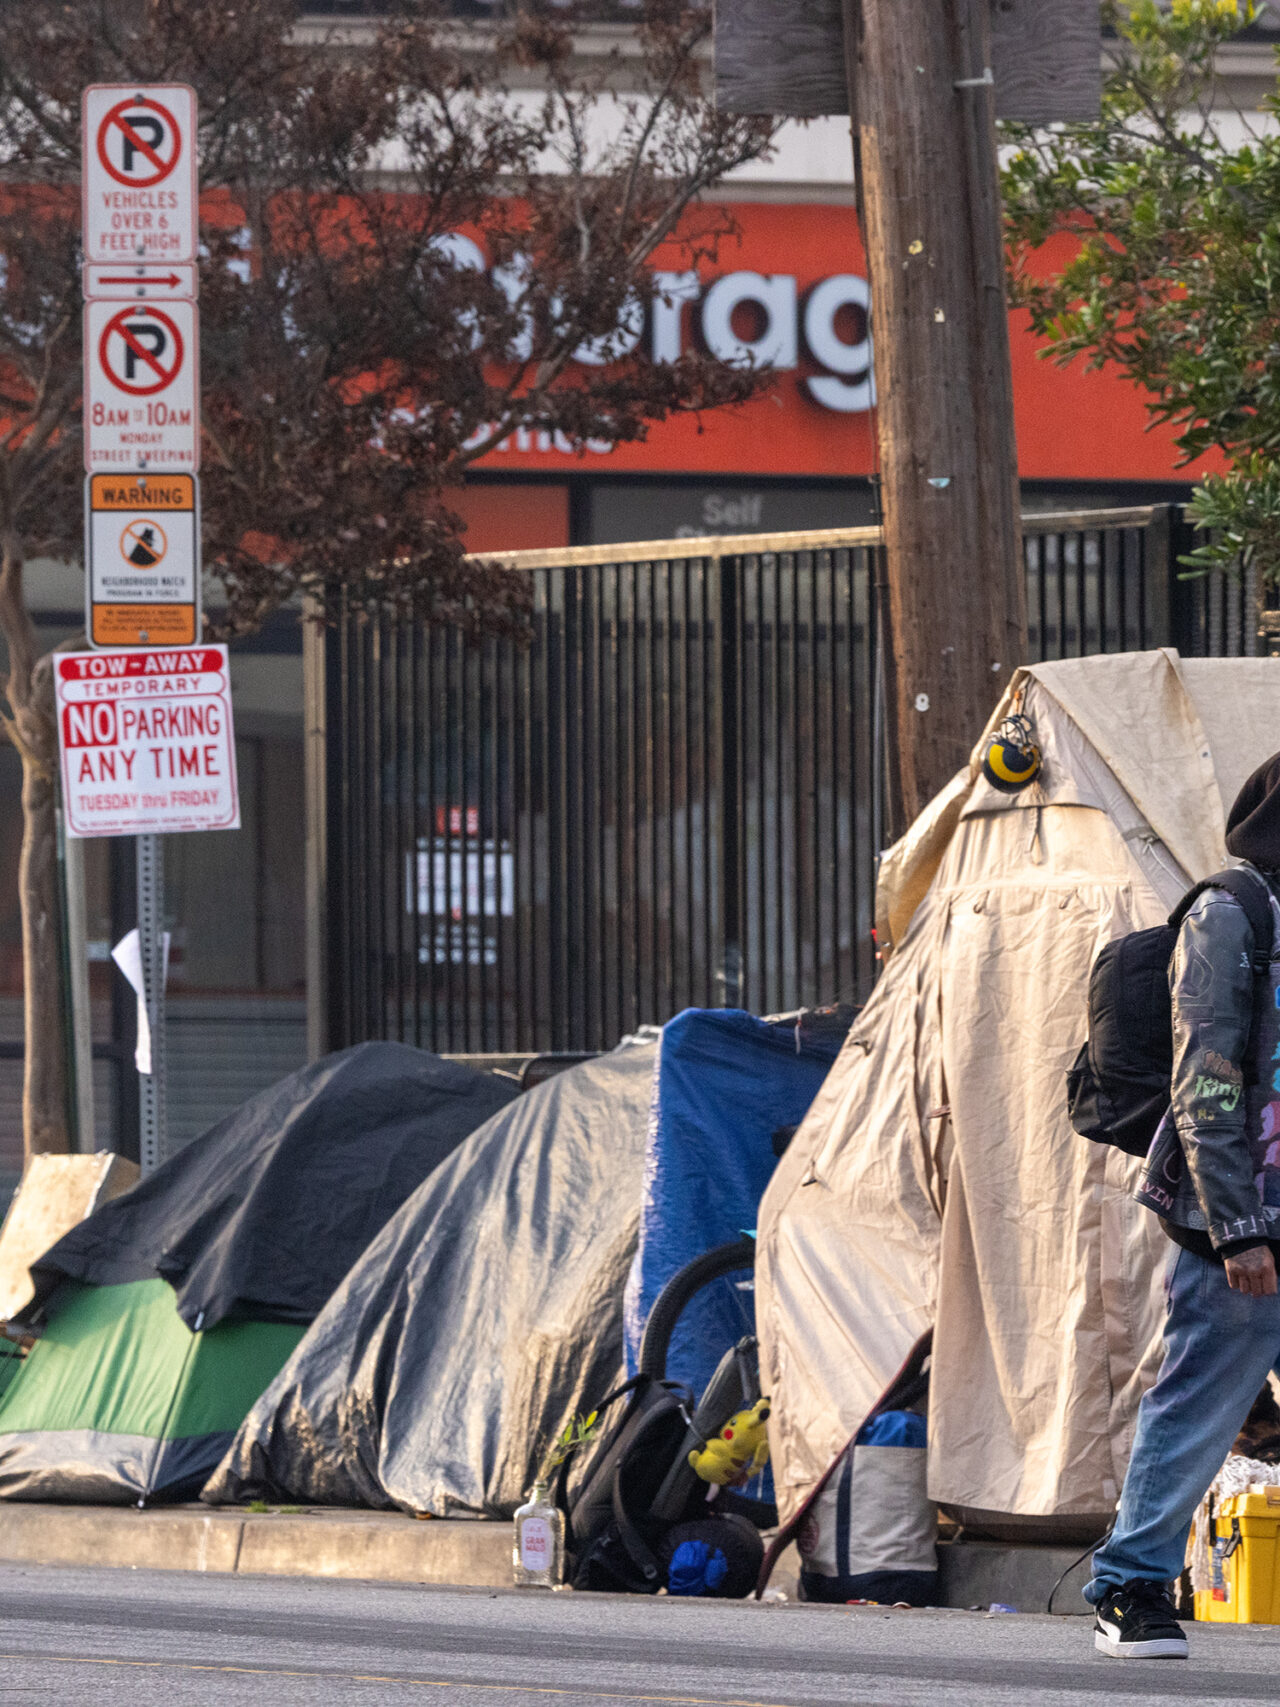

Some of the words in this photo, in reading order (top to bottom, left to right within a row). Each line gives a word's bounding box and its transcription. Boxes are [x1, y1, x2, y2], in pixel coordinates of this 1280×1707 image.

[102, 191, 178, 209] VEHICLES
[111, 212, 153, 230] OVER
[158, 212, 169, 229] 6
[100, 233, 137, 250] FEET
[143, 233, 181, 250] HIGH
[92, 402, 130, 427] 8AM
[147, 402, 192, 427] 10AM
[119, 432, 163, 444] MONDAY
[92, 449, 132, 463] STREET
[136, 449, 193, 463] SWEEPING
[102, 488, 184, 504] WARNING
[74, 652, 206, 678] TOW-AWAY
[83, 678, 202, 697] TEMPORARY
[68, 703, 117, 745] NO
[122, 704, 221, 740] PARKING
[78, 751, 136, 783] ANY
[149, 745, 221, 779] TIME
[78, 793, 139, 812] TUESDAY
[170, 789, 219, 808] FRIDAY
